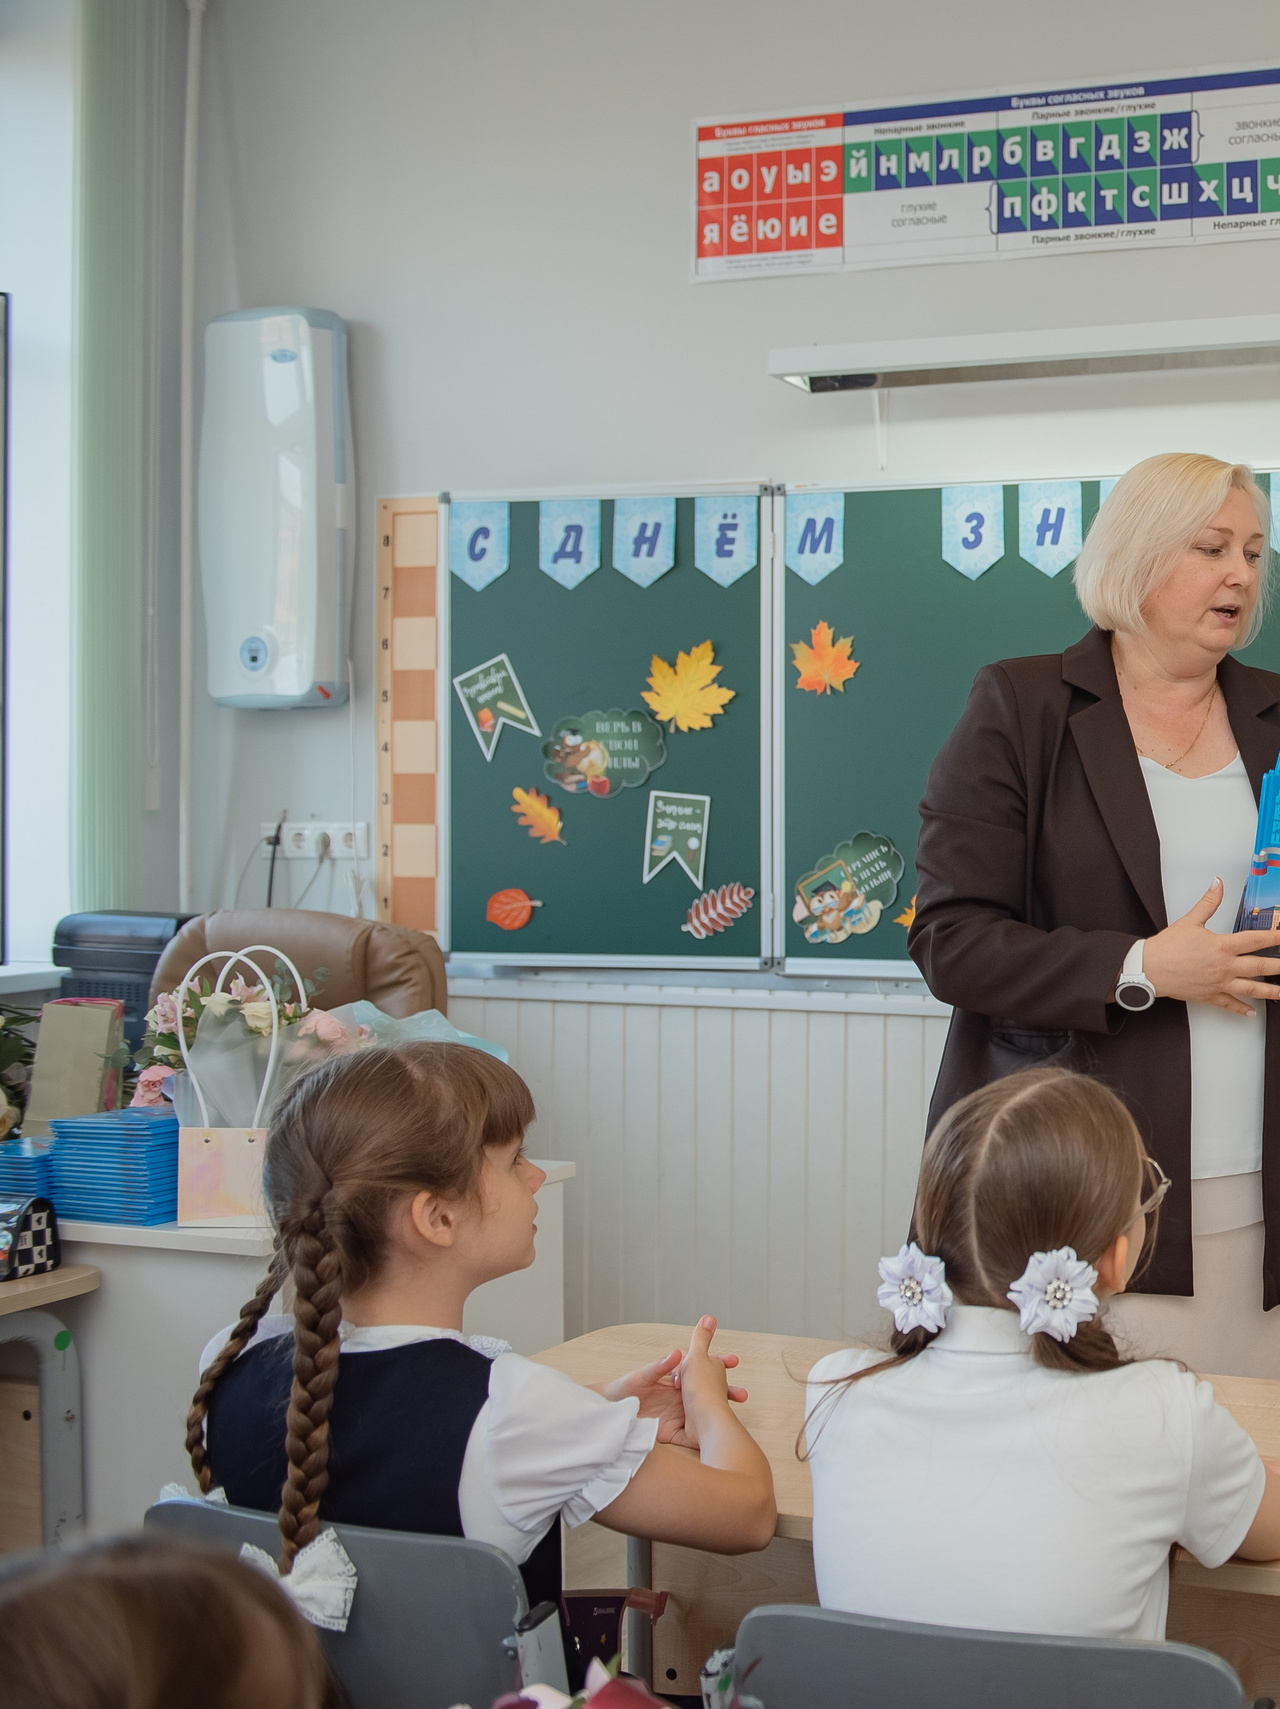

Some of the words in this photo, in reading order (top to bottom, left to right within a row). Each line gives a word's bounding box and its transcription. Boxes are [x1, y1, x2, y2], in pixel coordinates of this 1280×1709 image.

[901, 201, 938, 215] глухие
[891, 215, 948, 229] согласные
[1213, 218, 1267, 231] Непарные
[1031, 233, 1071, 245] Парные
[383, 535, 390, 547] 8
[382, 587, 390, 599] 7
[381, 638, 389, 651] 6
[381, 691, 389, 703] 5
[595, 721, 630, 734] ВЕРЬ
[381, 742, 389, 754] 4
[382, 793, 389, 805] 3
[382, 845, 389, 857] 2
[382, 897, 388, 909] 1
